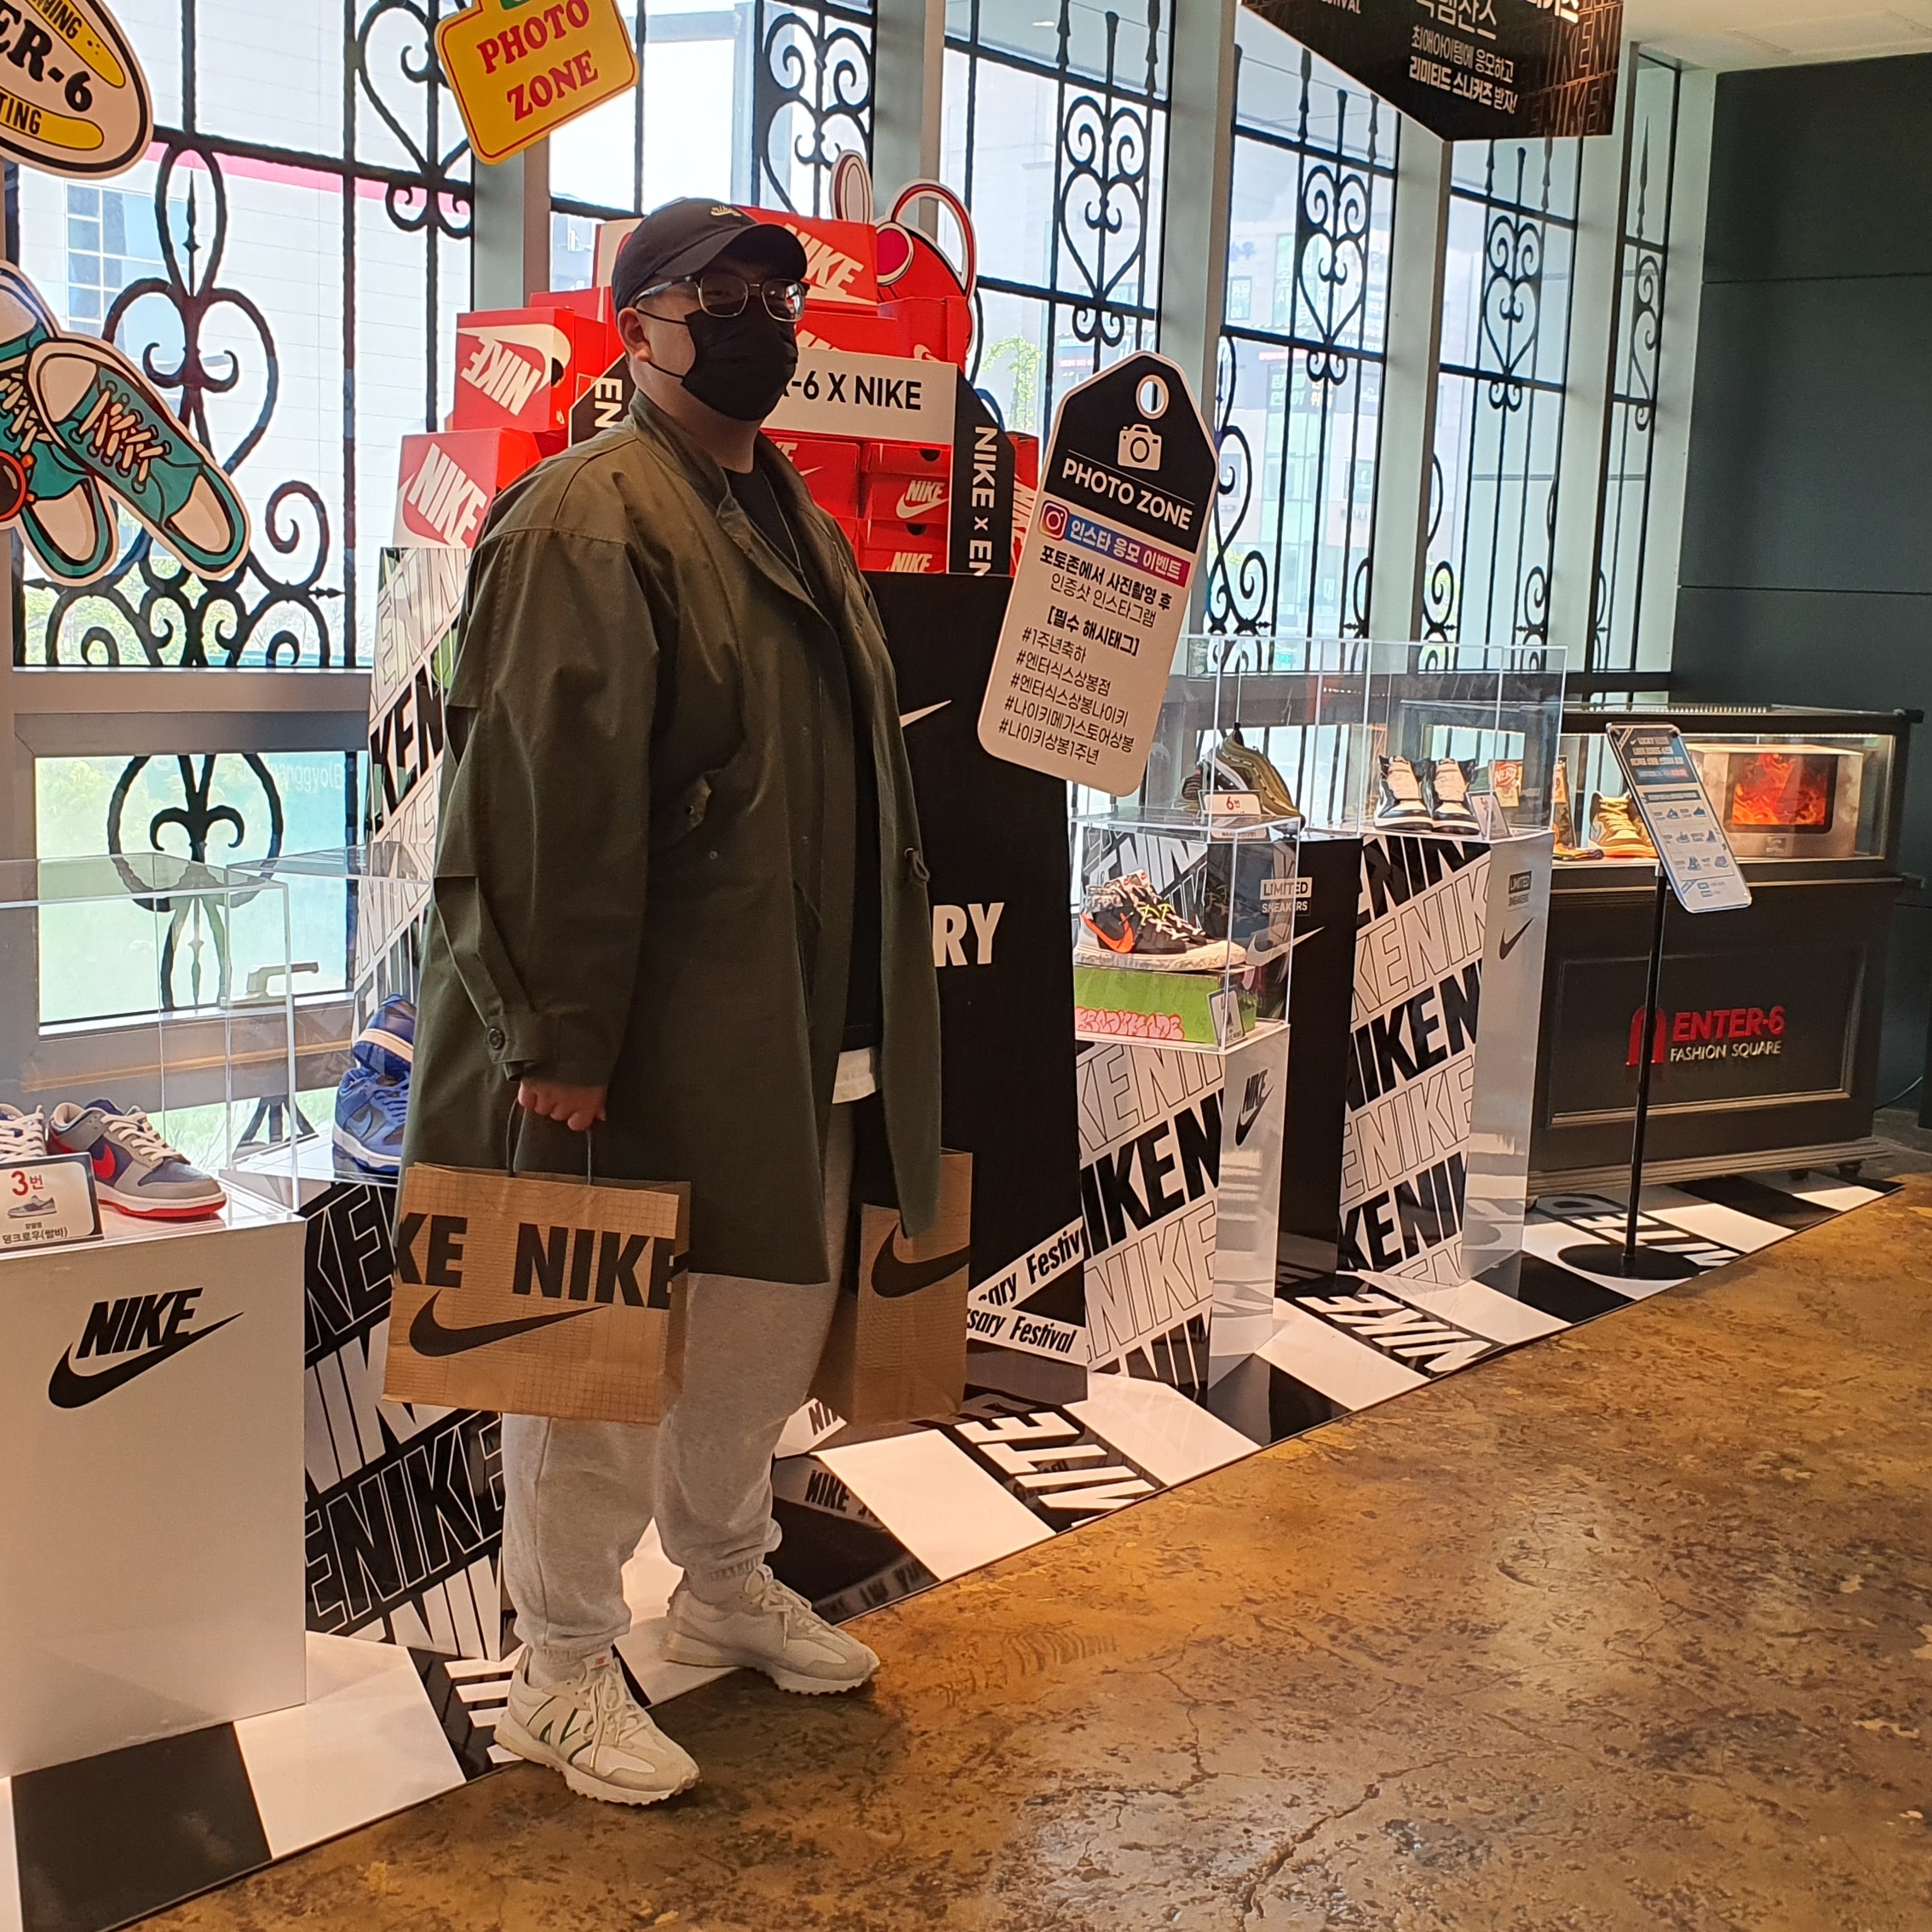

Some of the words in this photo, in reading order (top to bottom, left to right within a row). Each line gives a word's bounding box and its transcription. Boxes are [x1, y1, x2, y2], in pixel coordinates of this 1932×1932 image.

[476, 0, 589, 74] PHOTO
[507, 49, 599, 121] ZONE
[1409, 55, 1452, 91] 리미티드
[1452, 71, 1493, 106] 스니커즈
[1475, 48, 1515, 83] 응모하고
[461, 335, 542, 416] NIKE
[783, 371, 819, 400] -6
[826, 372, 847, 404] X
[854, 376, 922, 411] NIKE
[905, 480, 946, 503] NIKE
[971, 427, 998, 509] NIKE
[1062, 457, 1135, 505] PHOTO
[1136, 490, 1193, 531] ZONE
[407, 442, 488, 548] NIKE
[1070, 520, 1112, 552] 인스타
[1113, 538, 1141, 563] 응모
[1142, 549, 1182, 580] 이벤트
[1040, 545, 1106, 585] 포토존에서
[1107, 572, 1157, 605] 사진촬영
[1159, 592, 1173, 611] 후
[1050, 572, 1092, 602] 인증샷
[1093, 589, 1157, 629] 인스타그램
[1021, 626, 1087, 664] #1주년축하
[1047, 605, 1080, 633] [필수
[1082, 619, 1141, 657] 해시태그]
[1015, 649, 1112, 697] #엔터식스상봉점
[1004, 694, 1135, 753] #나이키메가스토어상봉
[1010, 672, 1129, 727] #엔터식스상봉나이키
[998, 718, 1100, 766] #나이키상봉1주년
[1262, 900, 1308, 913] SNEAKRS
[1263, 881, 1308, 897] LIMITED
[1672, 1005, 1785, 1042] ENTER-6
[1670, 1044, 1728, 1062] FASHION
[1731, 1040, 1782, 1058] SQUARE
[1241, 1068, 1268, 1114] NIKE
[513, 1222, 676, 1310] NIKE
[75, 1287, 204, 1360] NIKE
[967, 1309, 1008, 1338] sary
[1009, 1315, 1078, 1354] Festival
